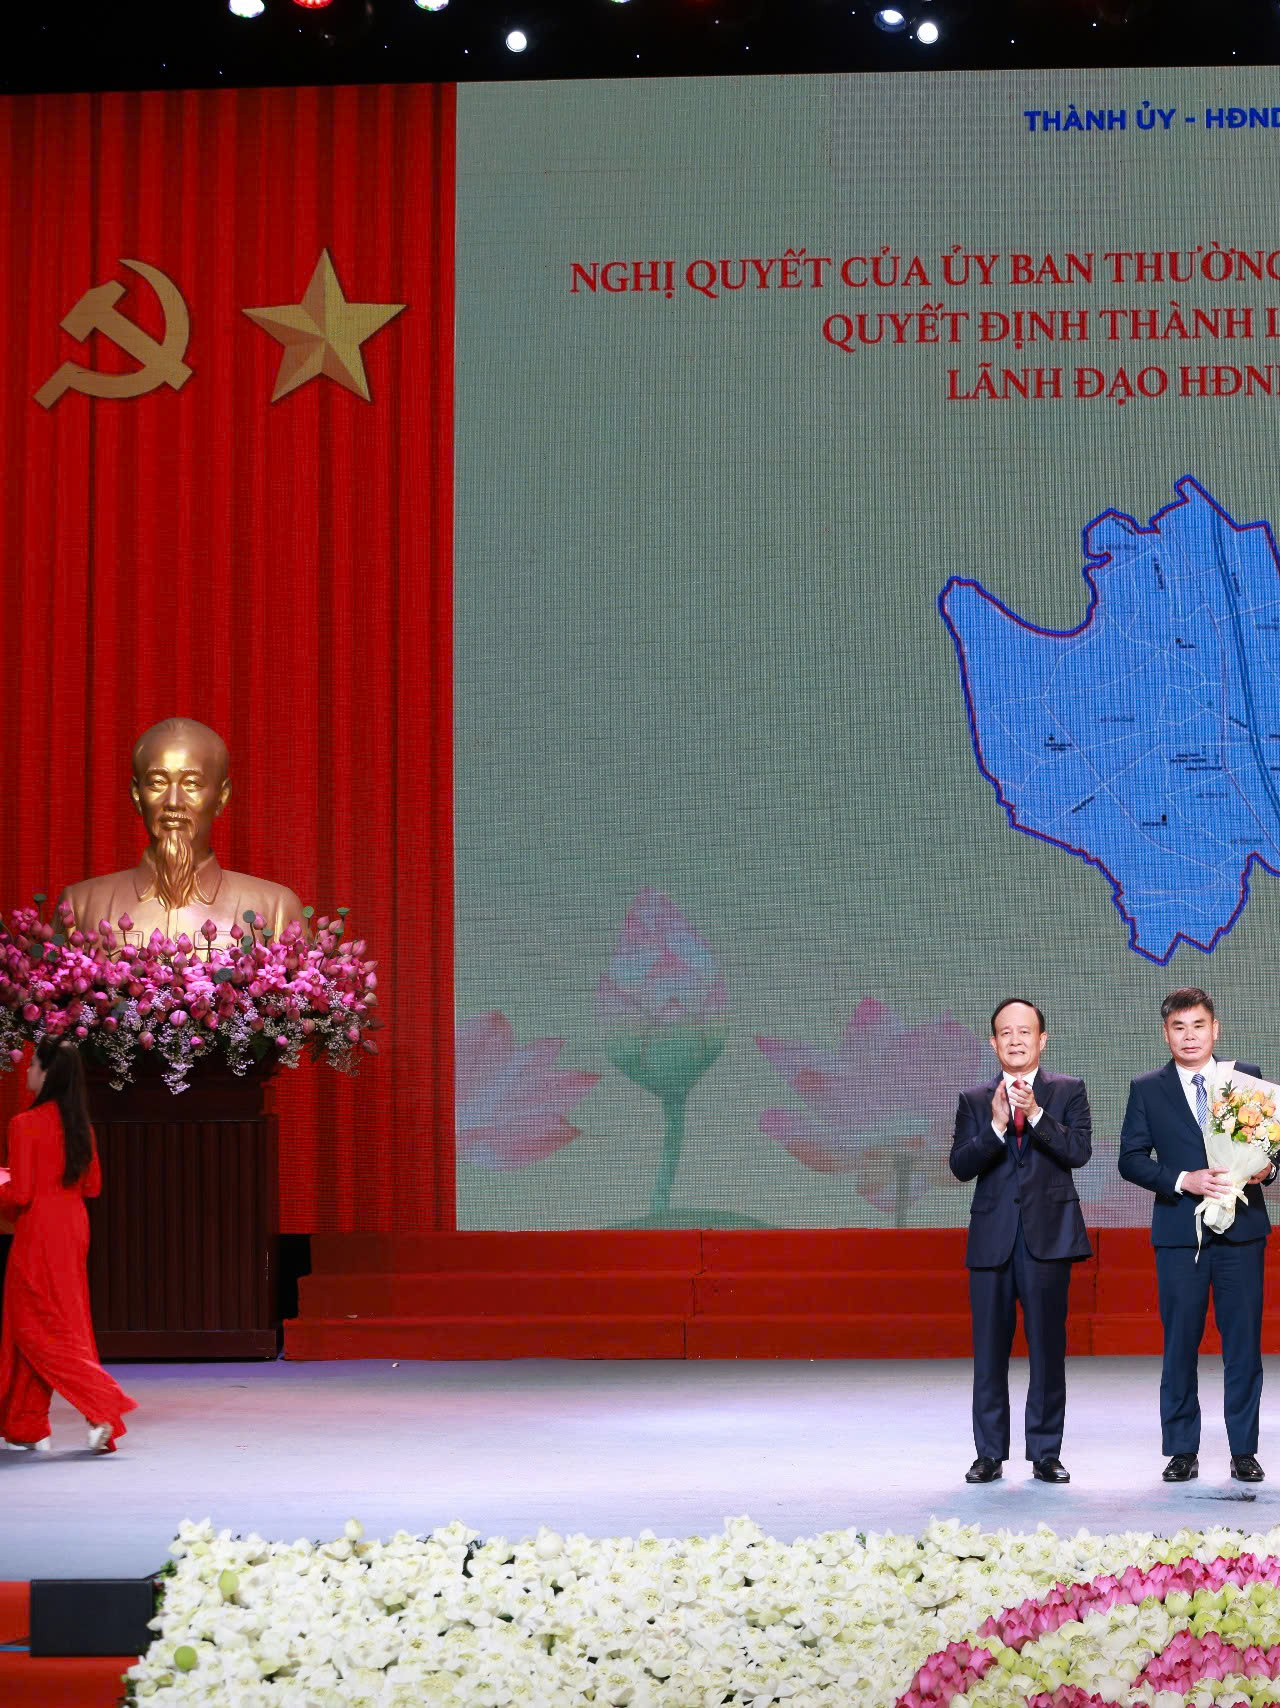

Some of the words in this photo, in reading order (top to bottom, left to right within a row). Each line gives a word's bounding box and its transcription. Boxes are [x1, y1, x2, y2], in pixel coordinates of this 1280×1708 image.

[1023, 104, 1127, 132] THÀNH
[1135, 100, 1176, 131] ỦY
[570, 259, 676, 300] NGHỊ
[685, 247, 832, 300] QUYẾT
[839, 245, 932, 289] CỦA
[941, 244, 999, 287] ỦY
[1010, 251, 1095, 286] BAN
[821, 302, 970, 354] QUYẾT
[978, 308, 1089, 351] ĐỊNH
[1099, 300, 1254, 341] THÀNH
[947, 361, 1062, 401] LÃNH
[1074, 365, 1169, 406] ĐẠO
